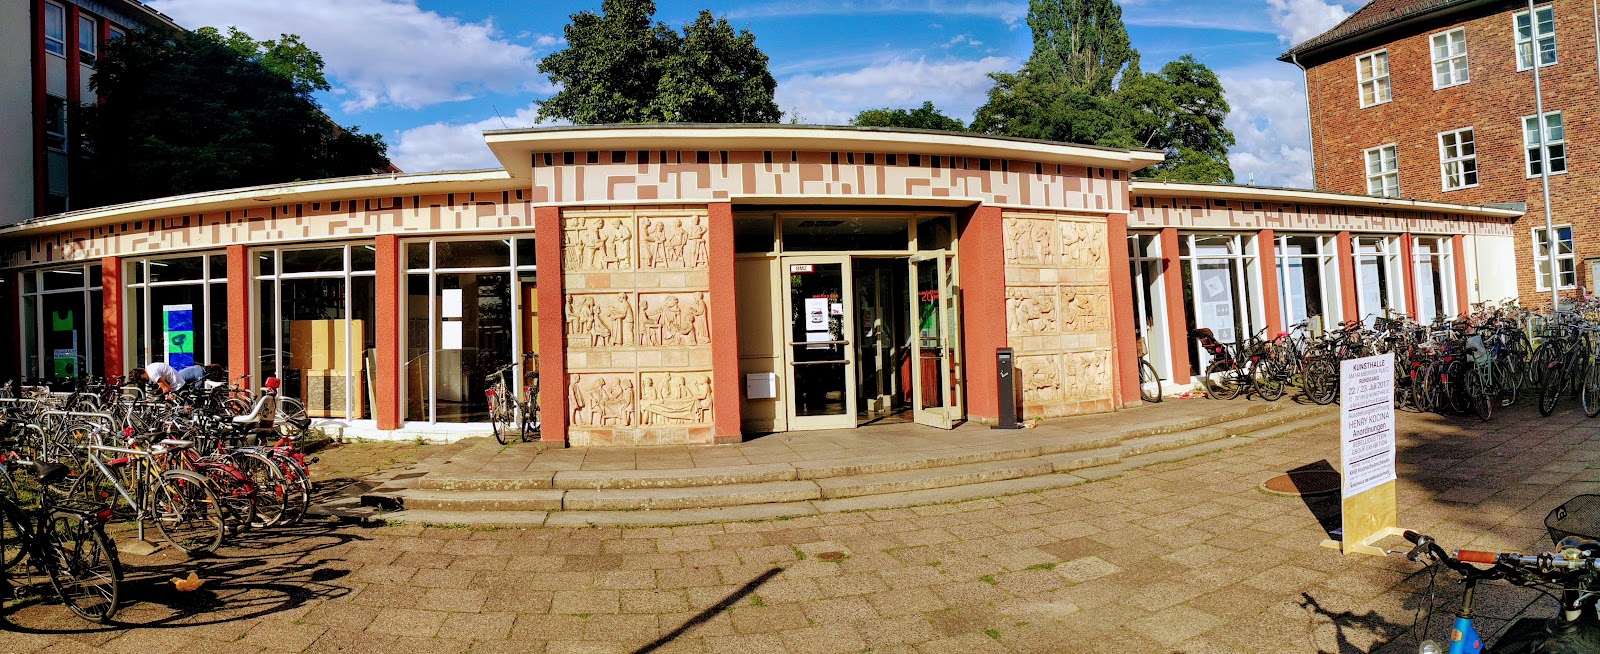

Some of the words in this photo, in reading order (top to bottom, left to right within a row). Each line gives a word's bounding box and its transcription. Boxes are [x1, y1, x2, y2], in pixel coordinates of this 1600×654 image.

[1353, 360, 1385, 371] KUNSTHALLE
[1355, 369, 1378, 377] HAMBURGER
[1359, 376, 1380, 384] RUNDGANG
[1368, 382, 1377, 391] Juli
[1377, 379, 1390, 389] 2017
[1348, 417, 1368, 430] HENRY
[1368, 411, 1390, 424] KOCINA
[1352, 422, 1387, 438] Anordnungen
